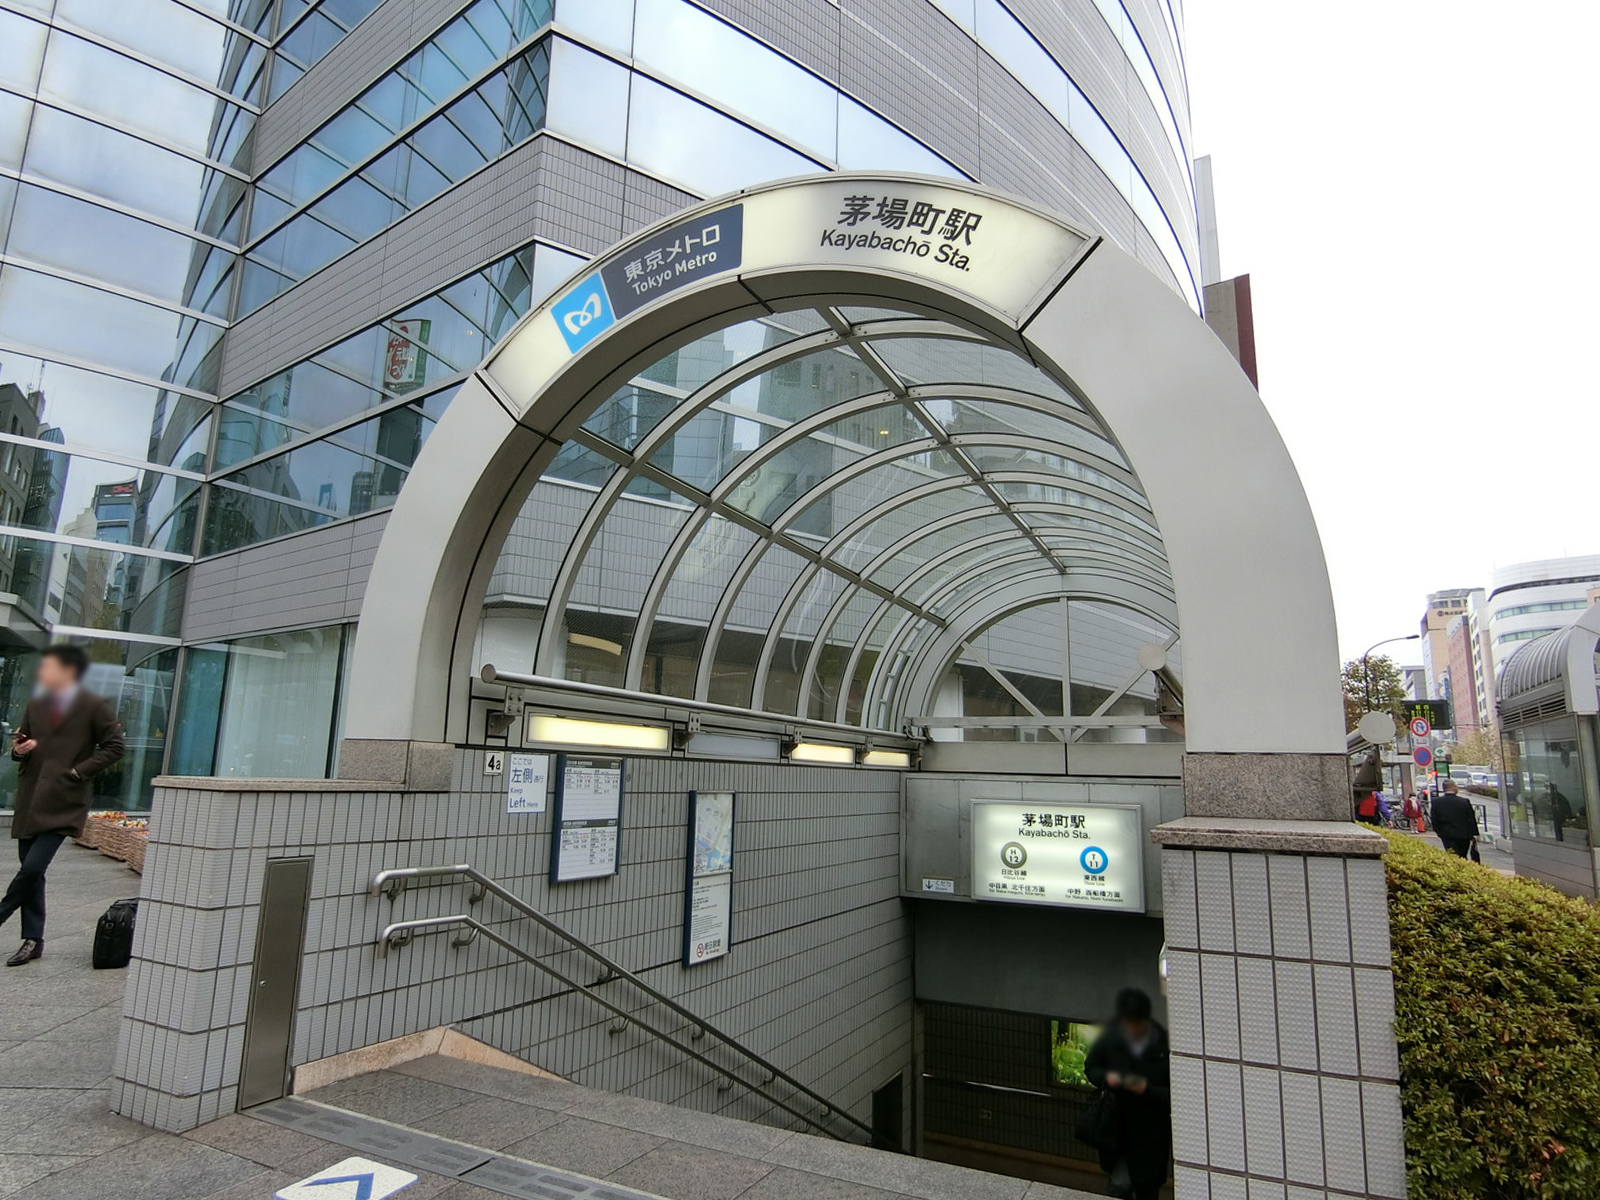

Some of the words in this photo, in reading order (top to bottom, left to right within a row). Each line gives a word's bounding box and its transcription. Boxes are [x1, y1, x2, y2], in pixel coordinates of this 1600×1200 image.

[837, 194, 982, 247] 茅場町駅
[625, 224, 721, 284] 東京メトロ
[820, 227, 932, 262] Kayabachō
[933, 242, 972, 272] Sta.
[632, 269, 673, 296] Tokyo
[675, 249, 718, 277] Metro
[488, 754, 501, 770] 4a
[512, 757, 533, 765] ここでは
[509, 797, 526, 808] Left
[1022, 813, 1086, 829] 茅場町駅
[1072, 830, 1091, 839] Sta.
[1089, 860, 1099, 868] 11
